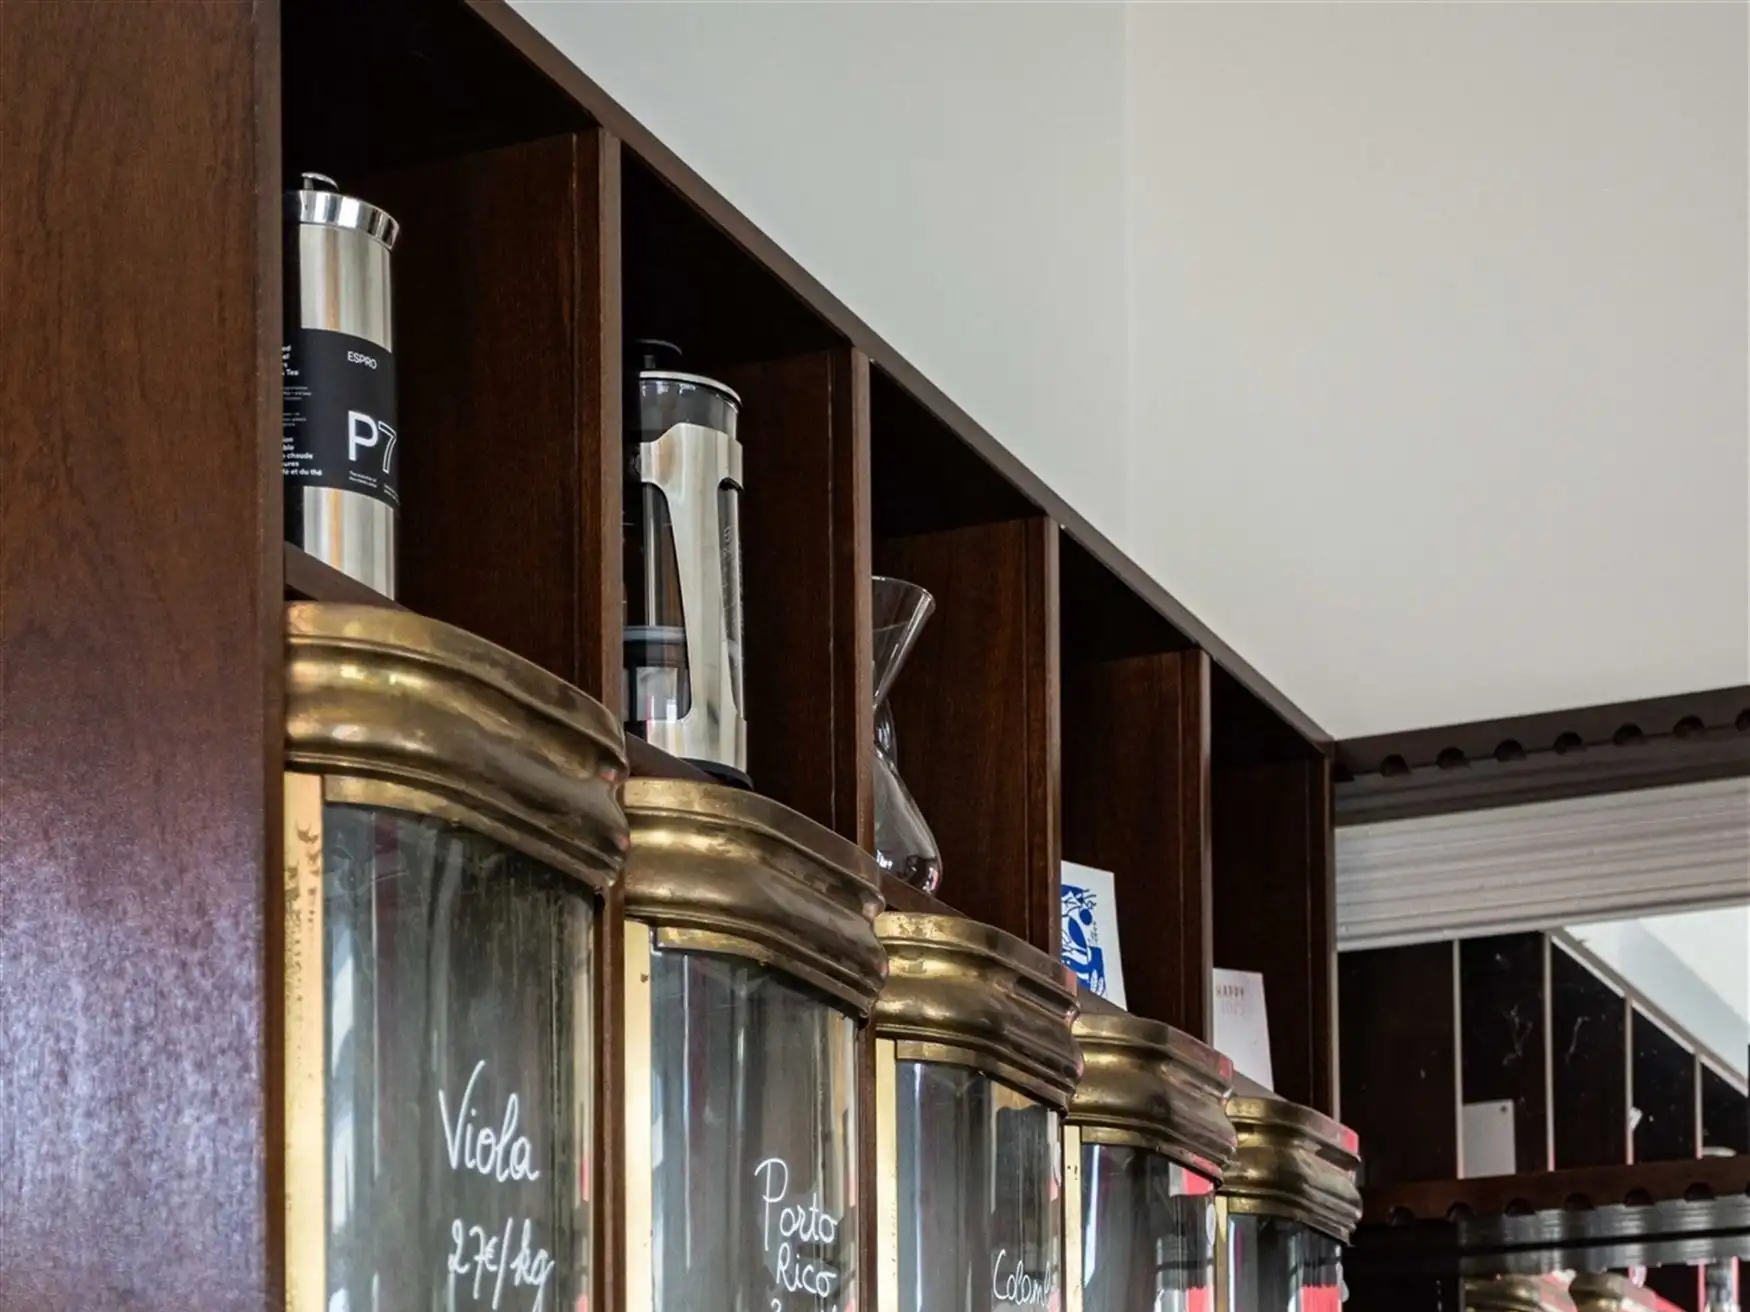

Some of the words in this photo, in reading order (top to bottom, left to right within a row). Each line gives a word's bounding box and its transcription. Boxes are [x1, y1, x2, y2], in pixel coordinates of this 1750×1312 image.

[347, 350, 377, 370] ESPRO
[348, 410, 397, 474] P7
[438, 1059, 540, 1182] Viola
[754, 1158, 838, 1251] Porto
[775, 1242, 838, 1298] Rico
